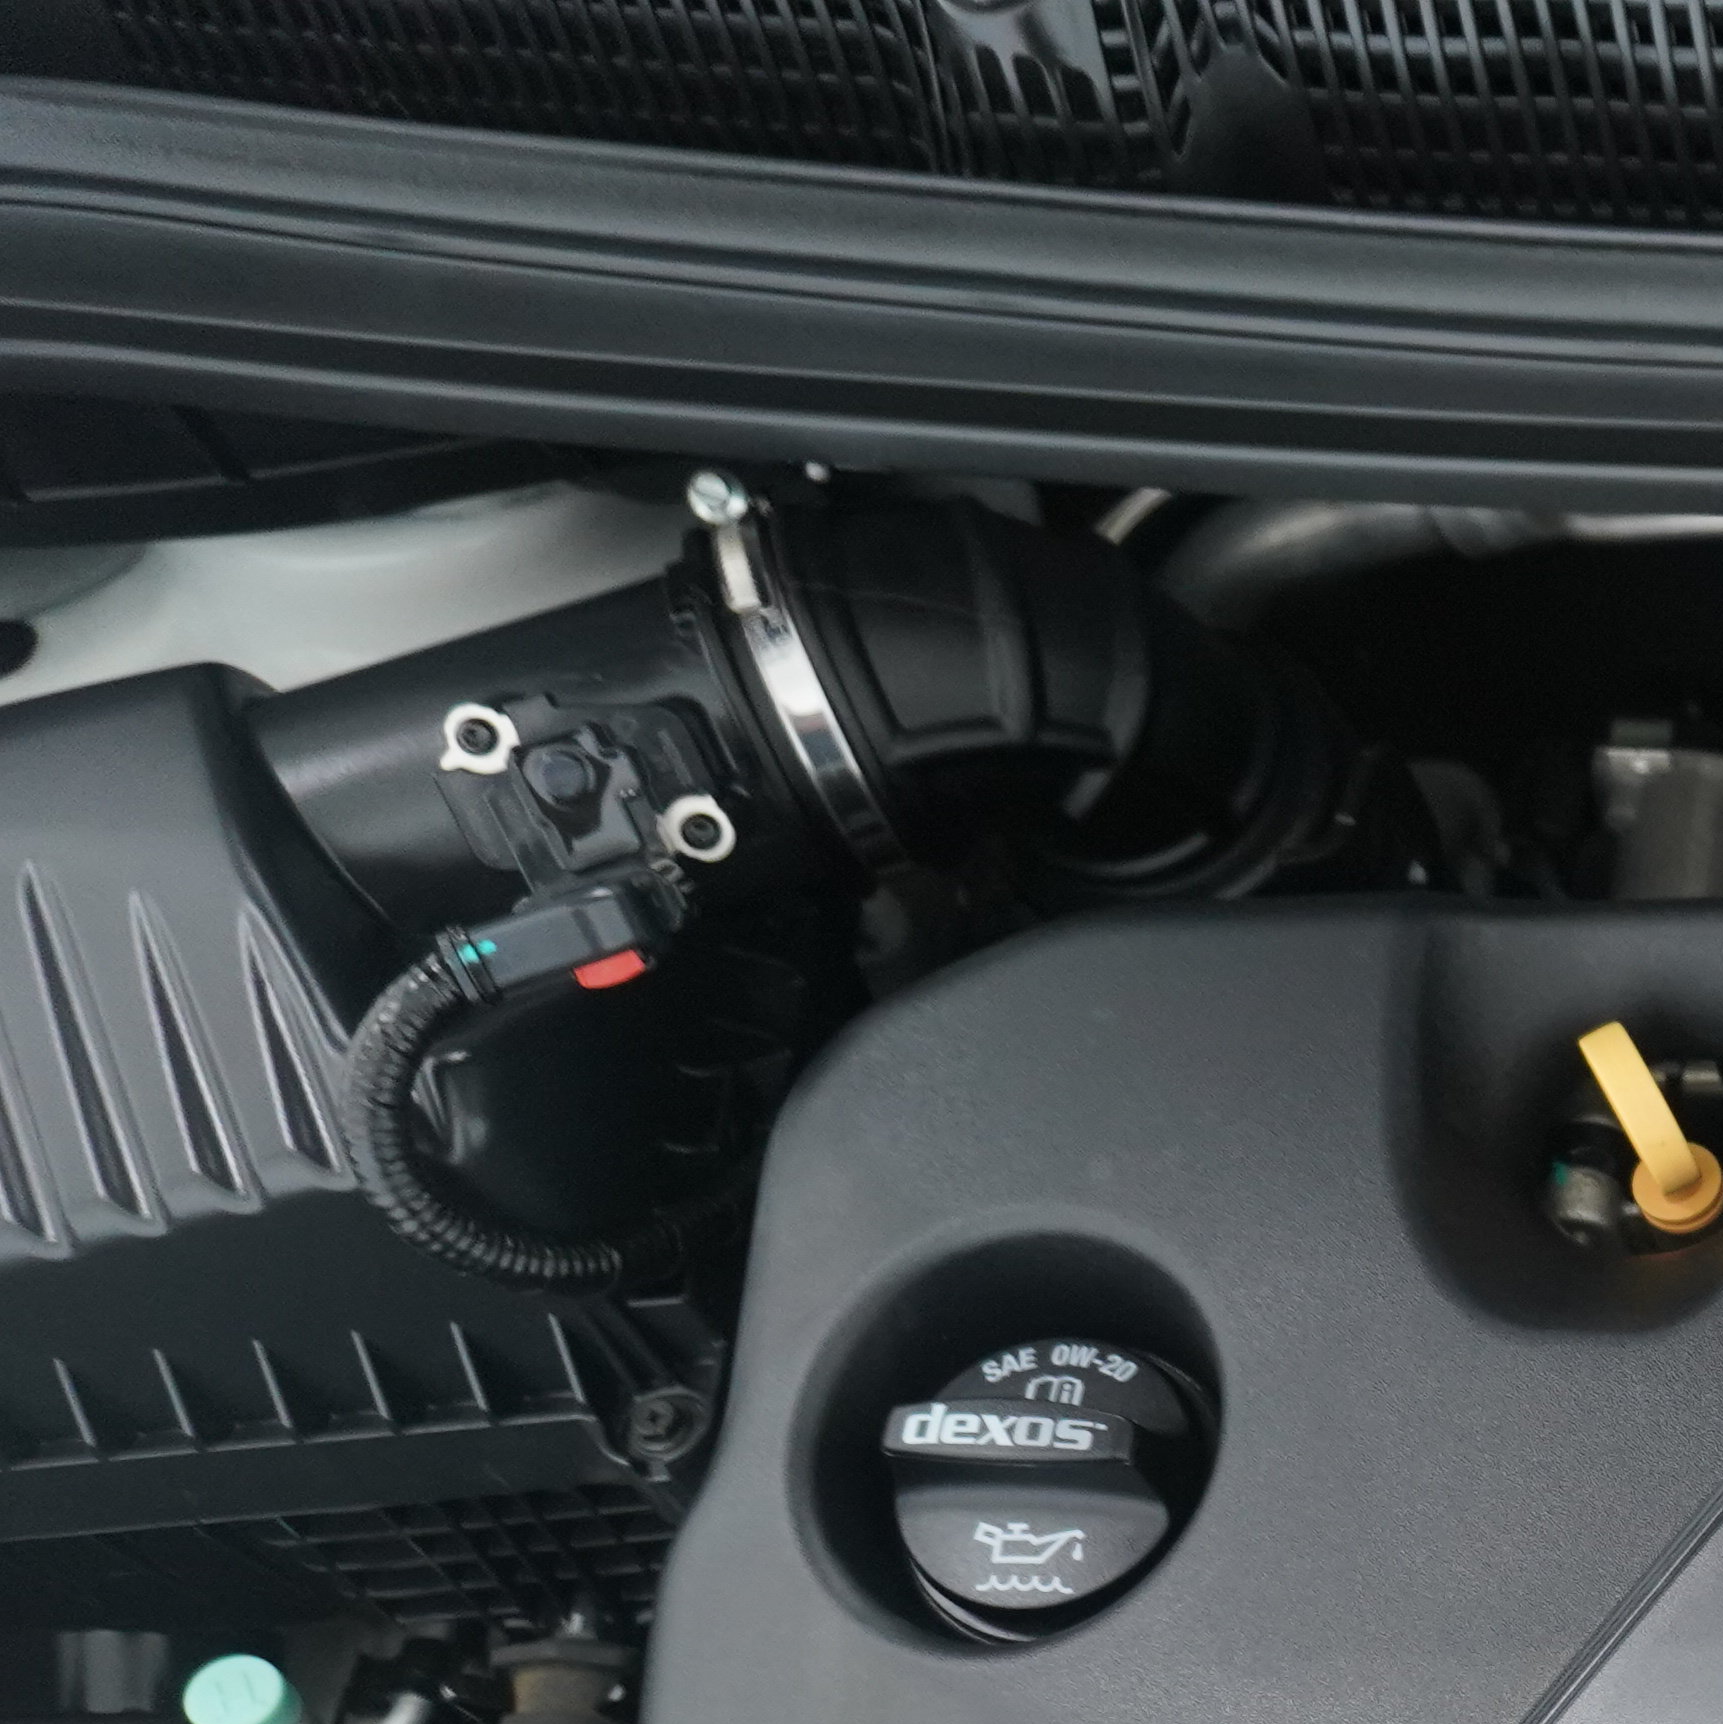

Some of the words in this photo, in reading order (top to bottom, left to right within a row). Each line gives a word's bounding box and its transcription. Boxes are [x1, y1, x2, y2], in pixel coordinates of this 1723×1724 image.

[981, 1348, 1038, 1382] SAE
[1051, 1344, 1138, 1383] 0W-20
[902, 1402, 1094, 1451] dexos
